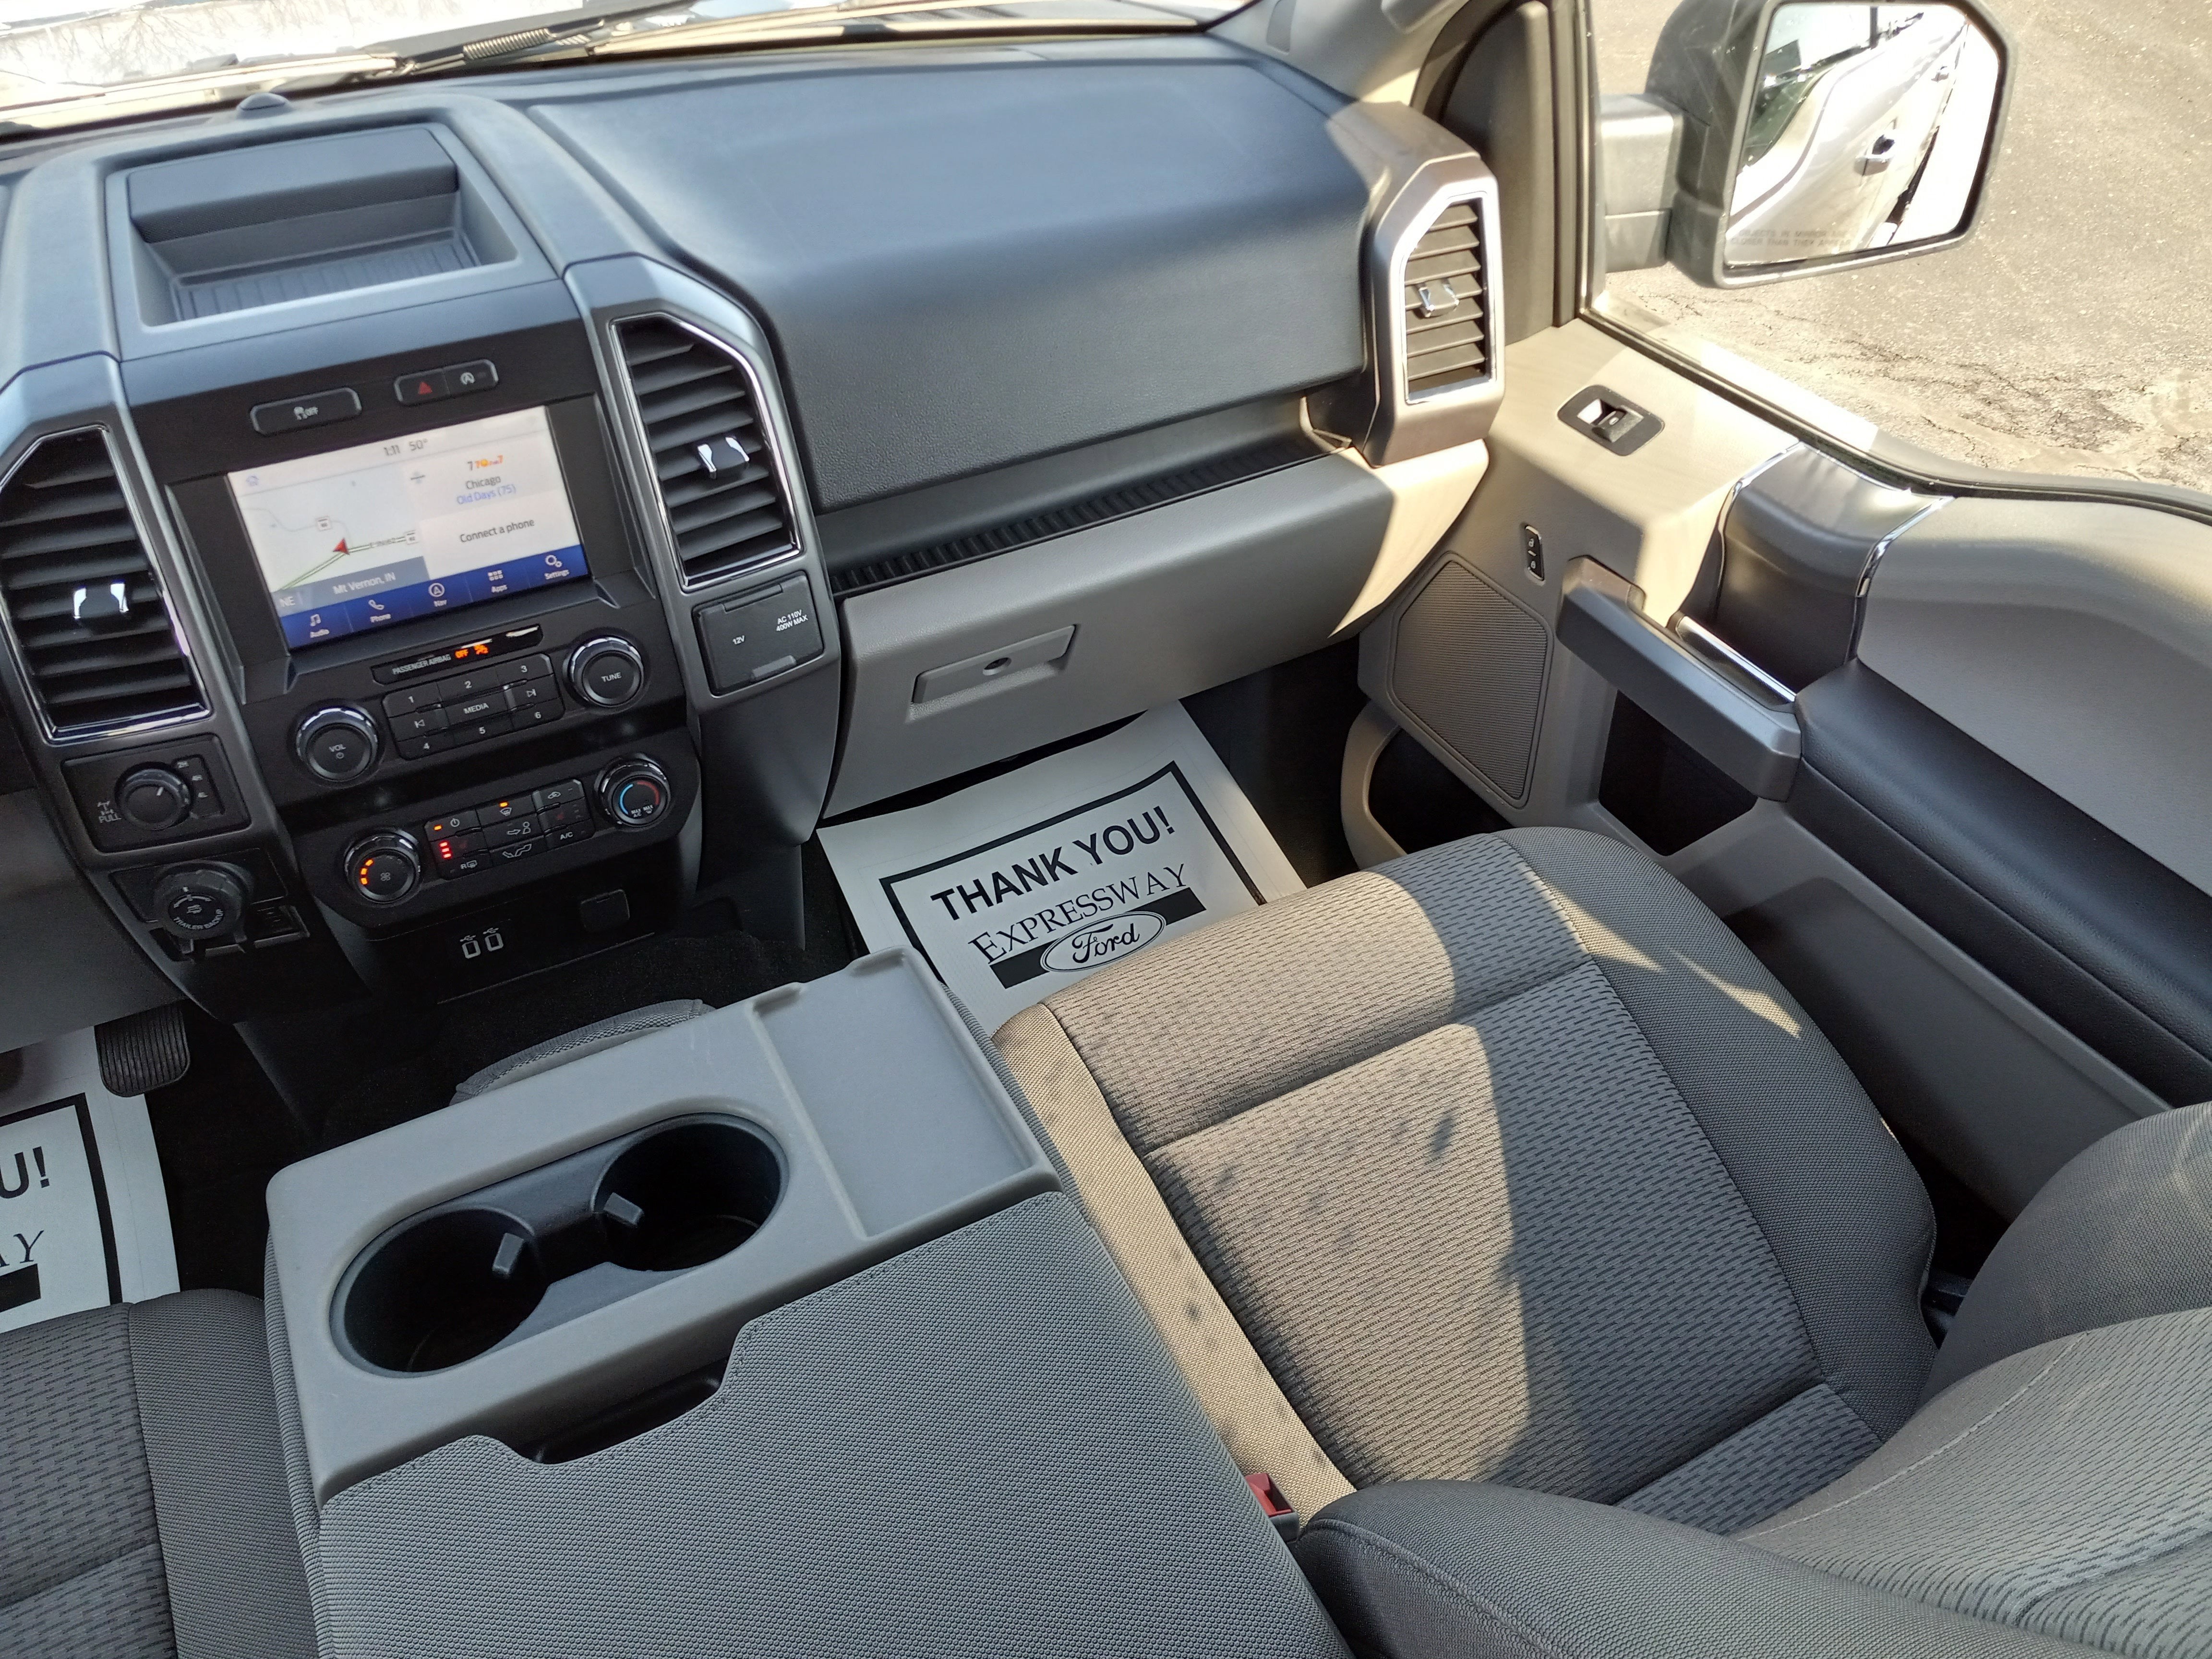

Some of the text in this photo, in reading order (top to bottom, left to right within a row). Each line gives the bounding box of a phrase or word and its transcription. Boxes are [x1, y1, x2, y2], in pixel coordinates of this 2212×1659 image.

[465, 476, 501, 490] Chicago
[456, 484, 517, 505] Old Days (75)
[459, 527, 497, 543] Connect
[506, 518, 535, 533] phone
[544, 569, 570, 580] Settings
[332, 583, 348, 594] Mt
[384, 572, 397, 582] IN
[491, 584, 508, 593] Apps
[279, 596, 296, 608] NE
[370, 613, 391, 623] Phone
[776, 614, 809, 632] 400W MAX
[777, 609, 802, 625] AC 110V
[309, 628, 330, 638] Audio
[732, 635, 745, 645] 12V
[392, 653, 452, 675] PASSENGER AIRBAG
[520, 665, 528, 673] 3
[601, 672, 622, 682] TUNE
[464, 680, 472, 689] 2
[463, 702, 490, 714] MEDIA
[328, 744, 346, 752] VOL
[98, 814, 122, 823] PULL
[560, 831, 574, 840] A/C
[930, 805, 1176, 921] THANK YOU!
[173, 909, 224, 930] TRAILER BACKUP
[968, 863, 1187, 964] EXPRESSWAY
[1071, 923, 1141, 964] Ford
